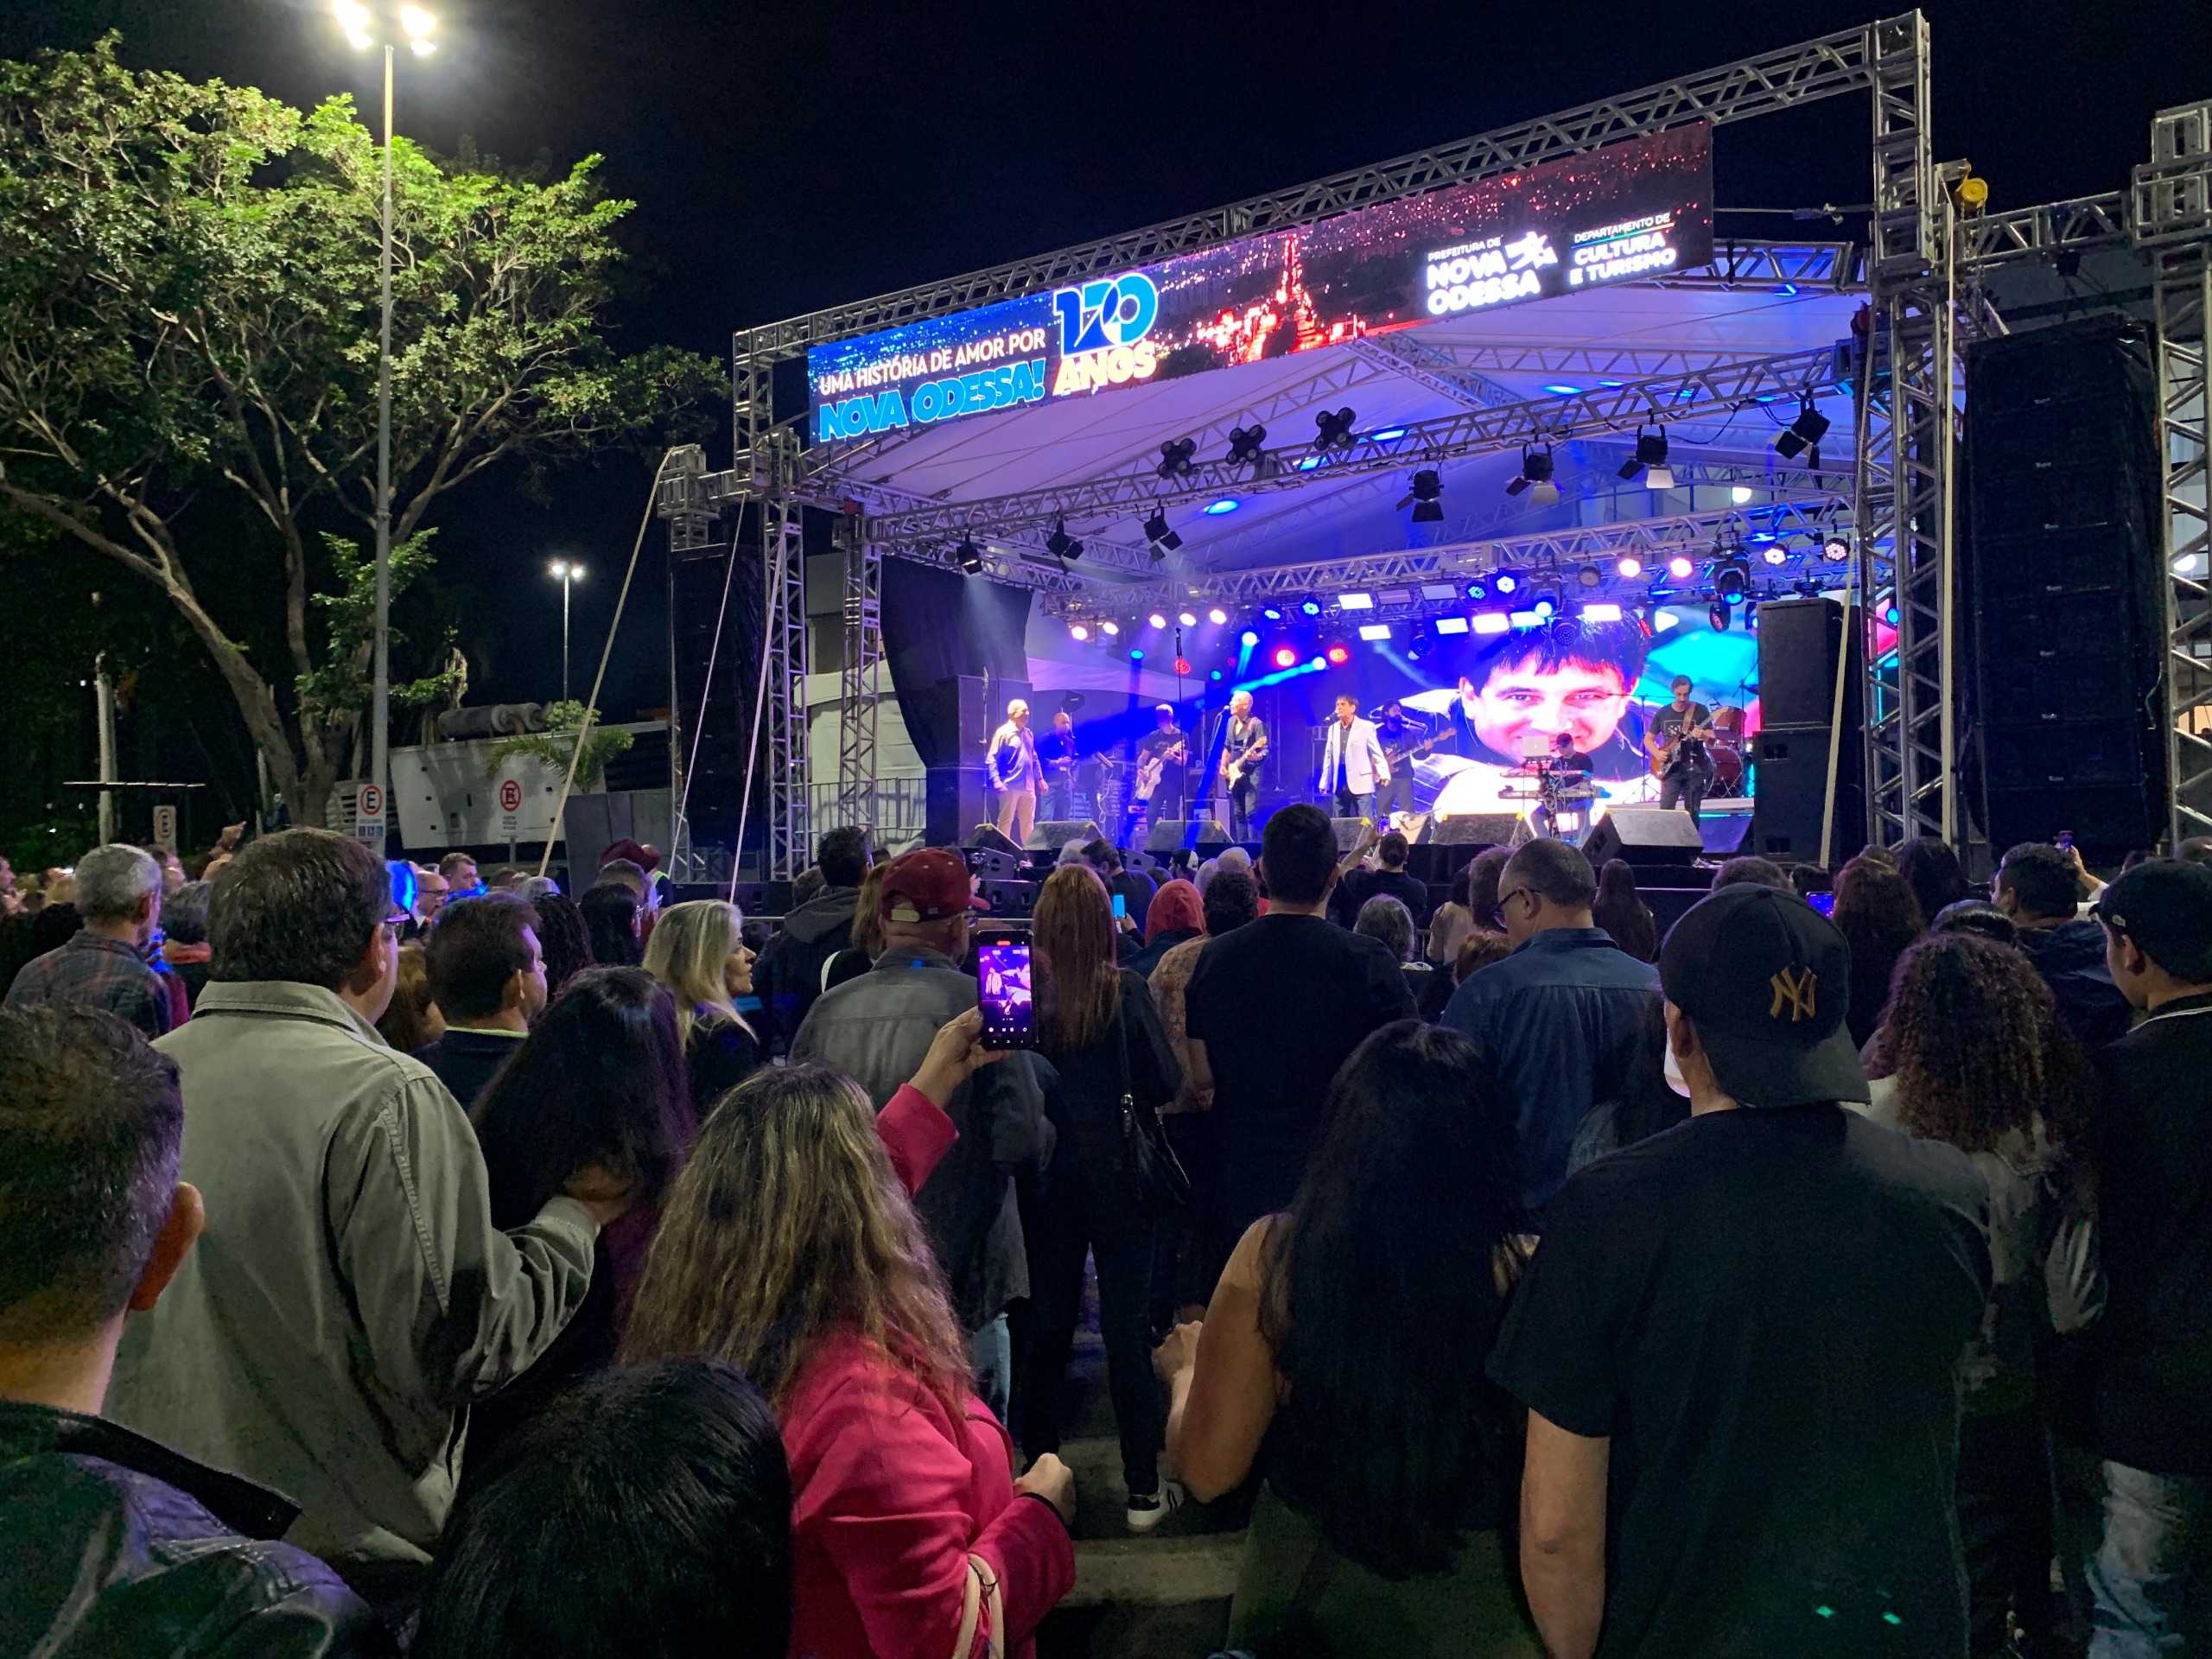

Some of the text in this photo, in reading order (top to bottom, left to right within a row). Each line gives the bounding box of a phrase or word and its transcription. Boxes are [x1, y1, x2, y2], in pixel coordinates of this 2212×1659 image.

[1574, 213, 1671, 244] DEPARTAMENTO DE
[1427, 237, 1501, 262] PREFEITURA DE
[1570, 248, 1676, 285] E TURISMO
[1574, 232, 1666, 265] CULTURA
[1427, 250, 1507, 289] NOVA
[1427, 270, 1541, 315] ODESSA
[820, 328, 1046, 396] UMA HISTÓRIA DE AMOR POR
[1052, 340, 1157, 397] ANOS
[819, 357, 1046, 442] NOVA ODESSA!
[366, 791, 376, 810] E
[1770, 966, 1817, 1021] NY
